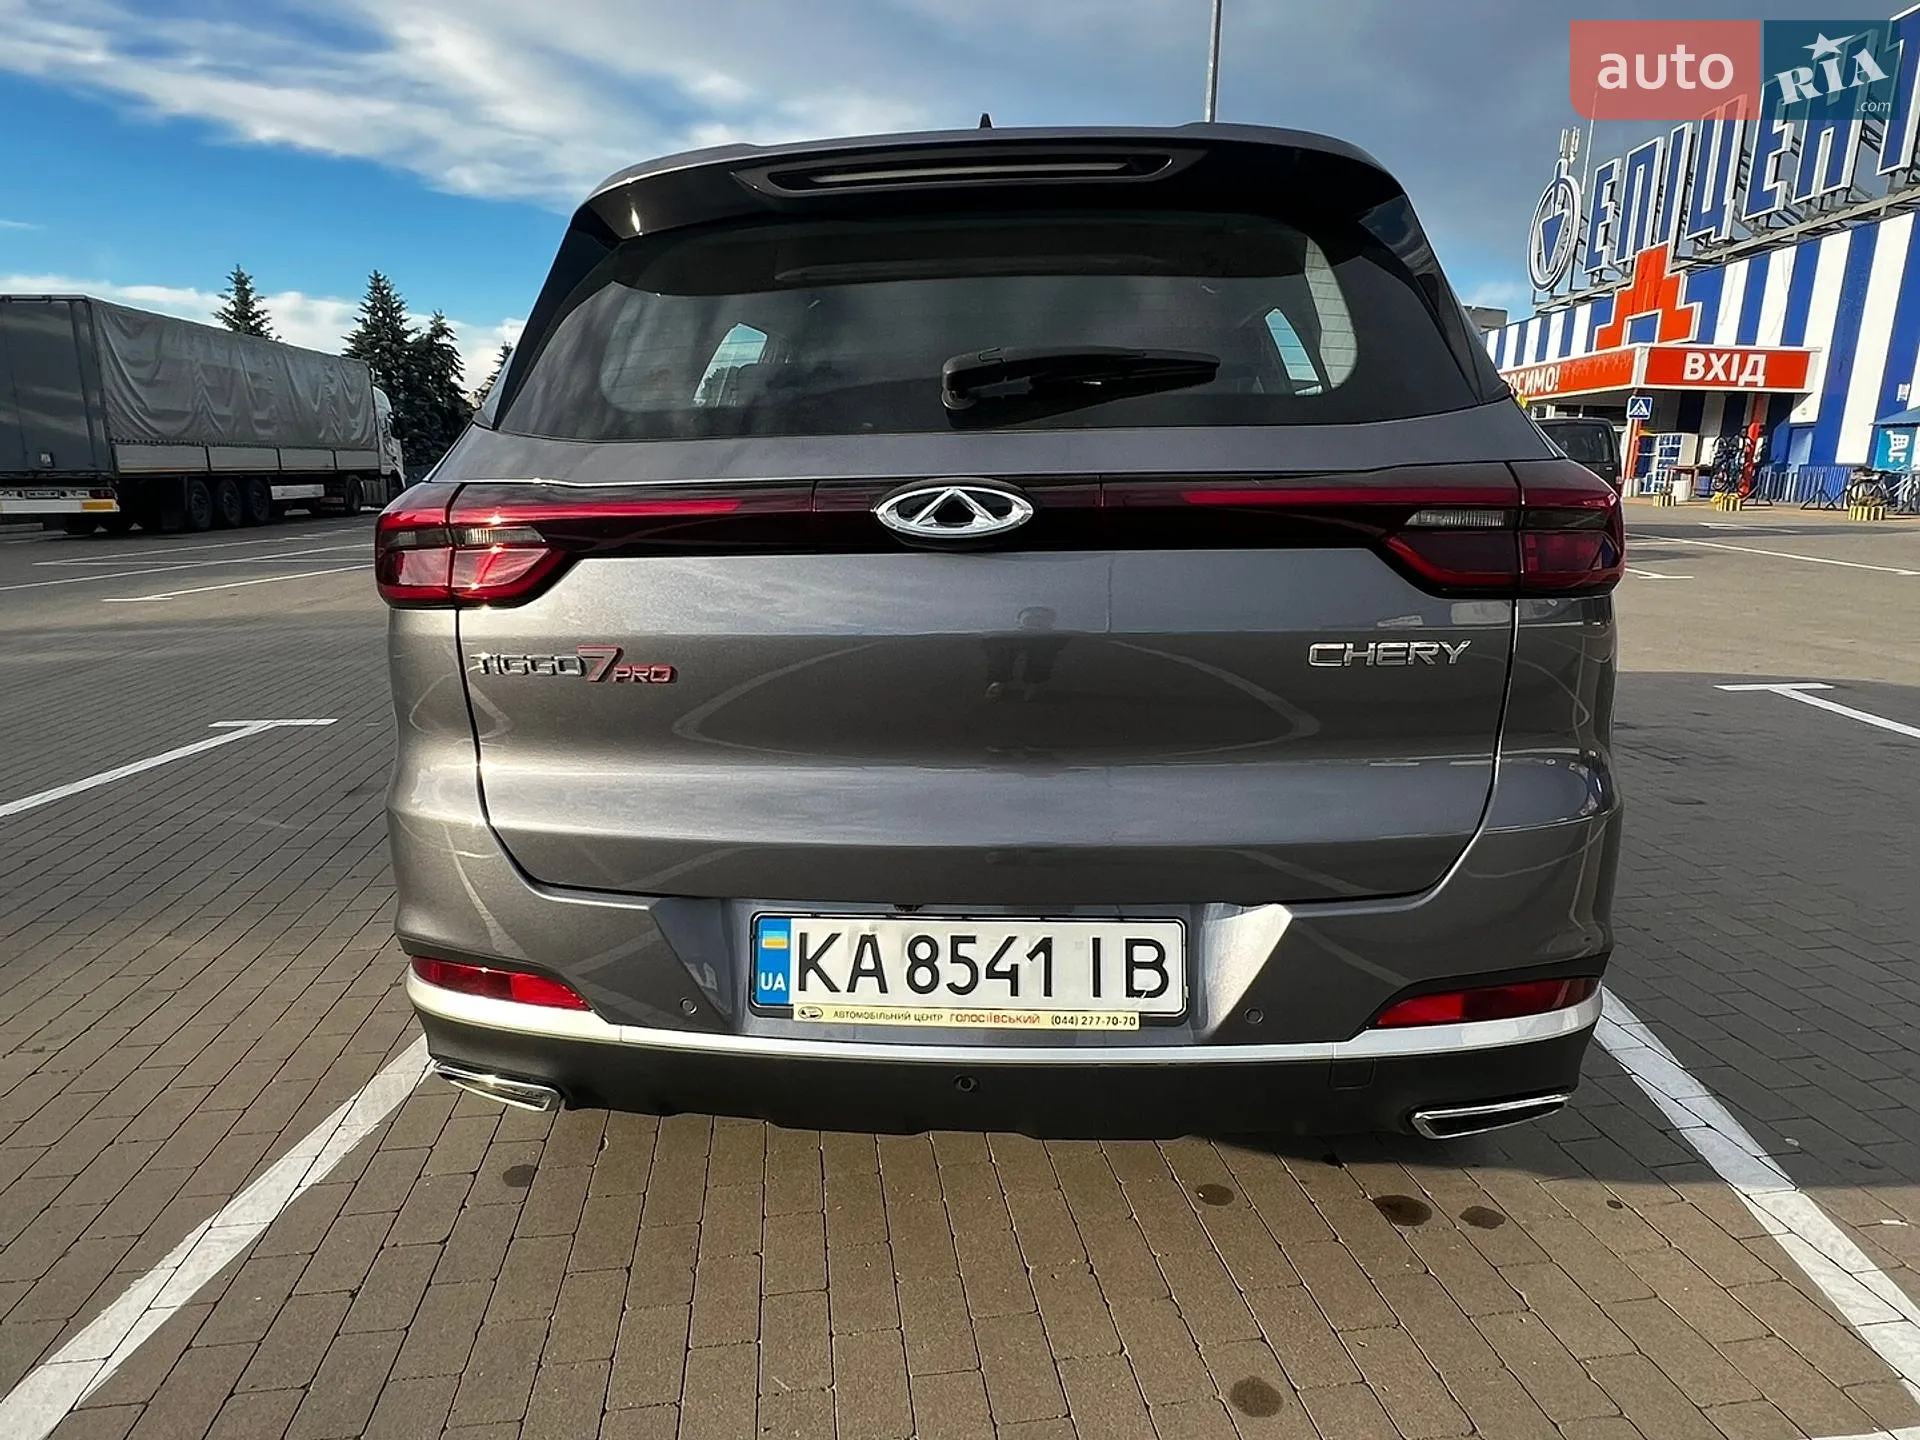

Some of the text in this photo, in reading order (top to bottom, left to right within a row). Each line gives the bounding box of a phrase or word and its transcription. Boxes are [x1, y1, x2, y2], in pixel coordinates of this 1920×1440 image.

[1682, 352, 1767, 387] ВХІД
[1308, 640, 1472, 667] CHERY
[612, 664, 678, 683] PRO
[798, 931, 1170, 998] KA 8541 IB
[760, 972, 787, 992] UA
[833, 1010, 1137, 1027] АВТОМОБІЛЬНИЙ ЦЕНТР ГОЛОСІЇВСЬКИЙ (044) 277-70-70
